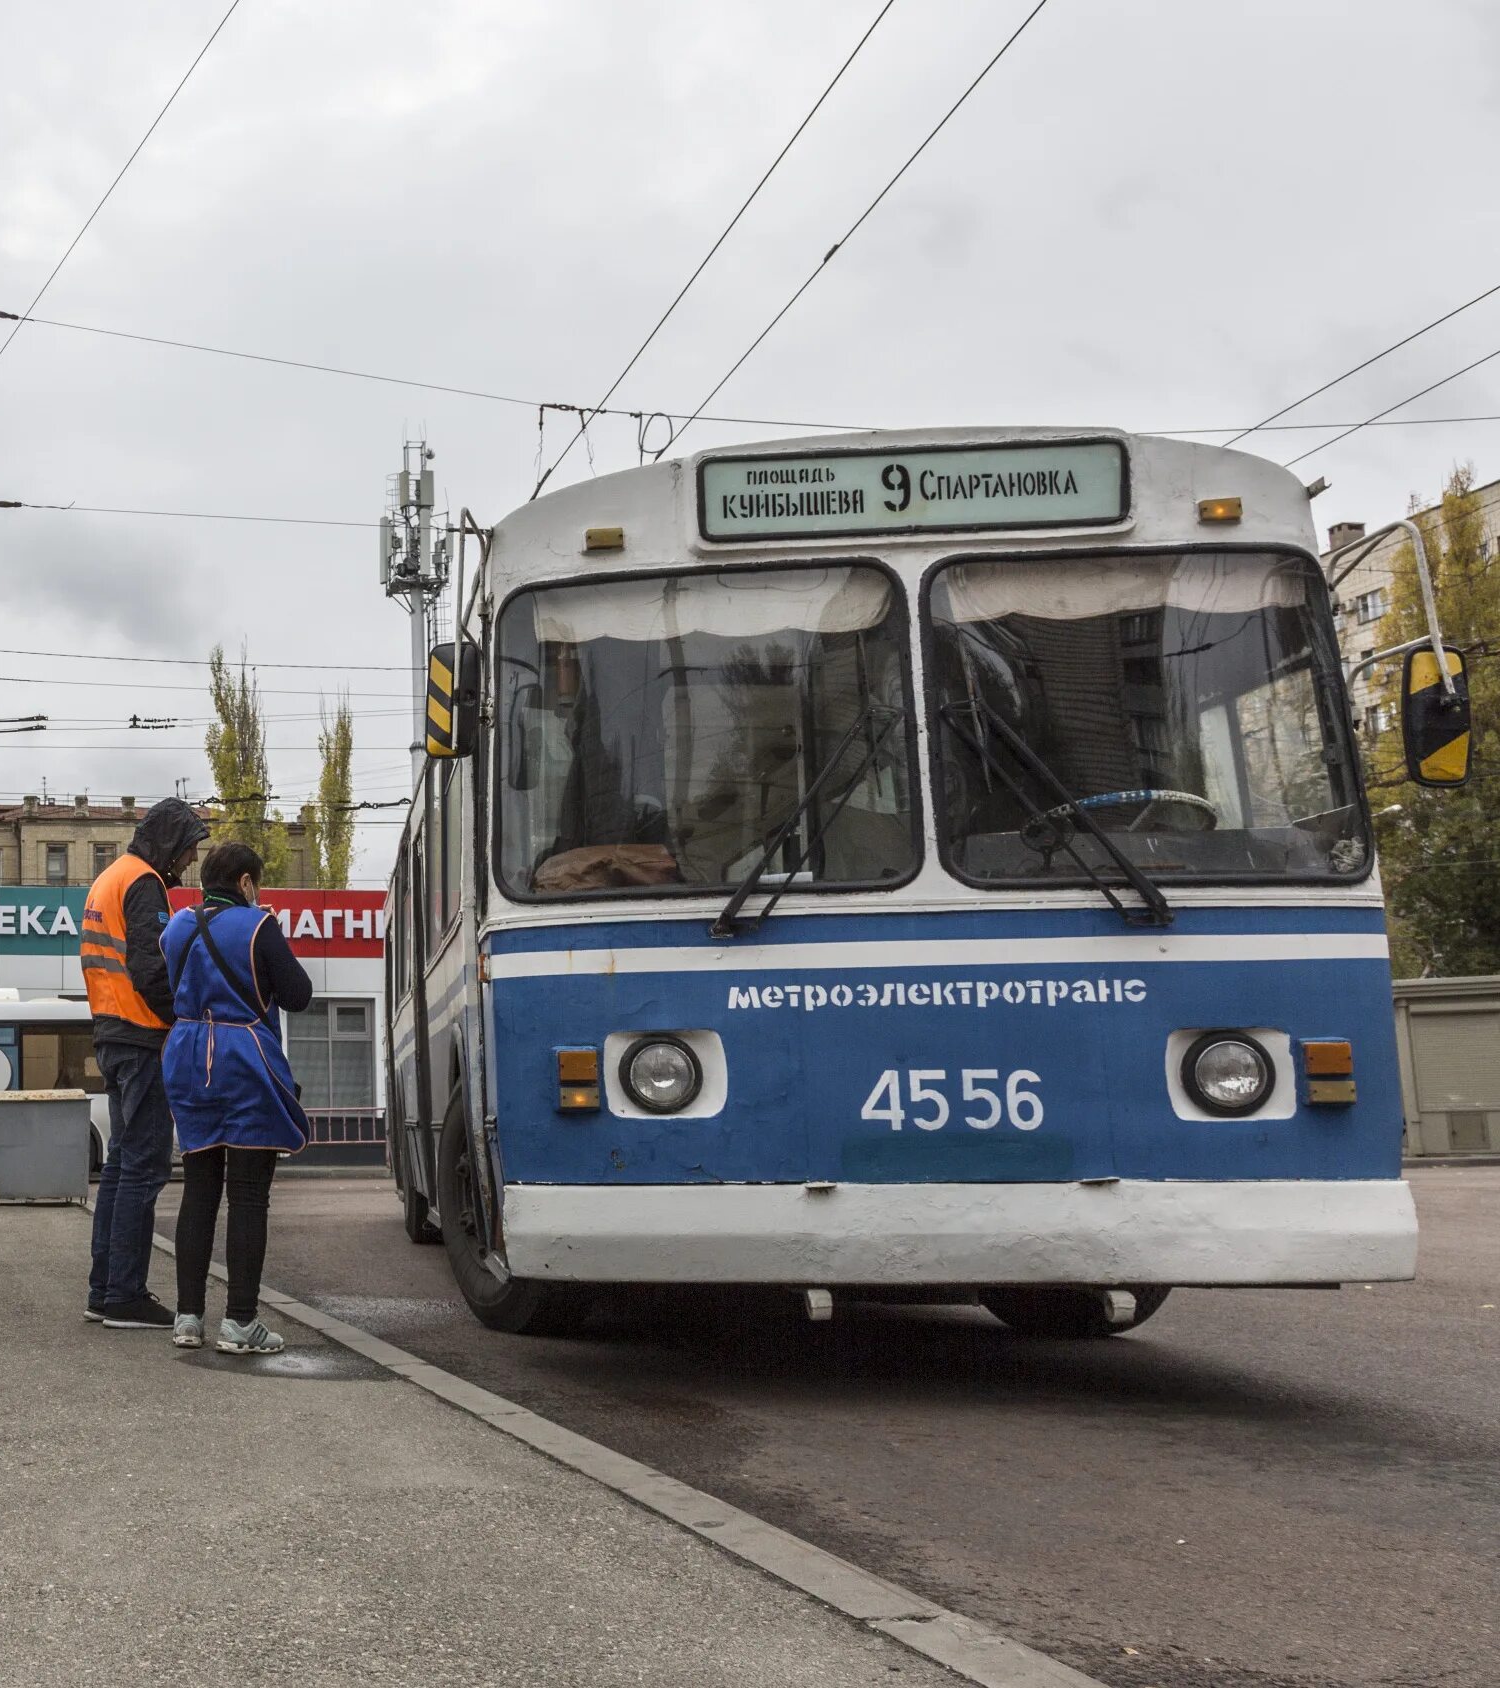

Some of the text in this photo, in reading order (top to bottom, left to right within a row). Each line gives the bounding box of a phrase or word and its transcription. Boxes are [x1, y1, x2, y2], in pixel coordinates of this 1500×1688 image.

[721, 488, 866, 520] КУЙБЫШЕВА
[880, 463, 911, 513] 9
[728, 978, 1147, 1012] метроэлектротранс
[860, 1068, 1044, 1132] 4556
